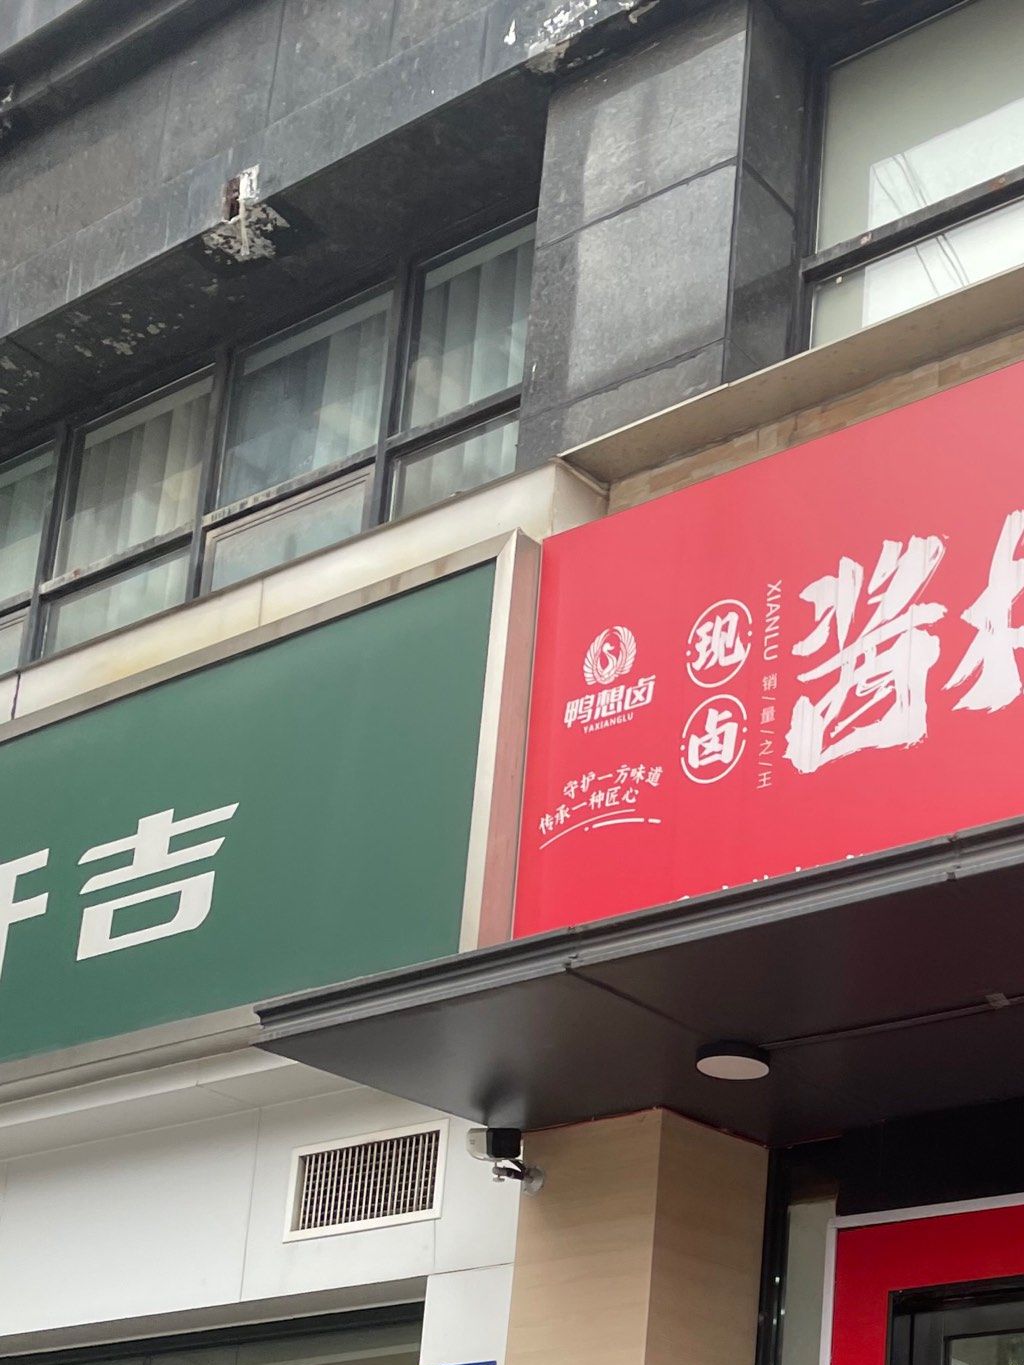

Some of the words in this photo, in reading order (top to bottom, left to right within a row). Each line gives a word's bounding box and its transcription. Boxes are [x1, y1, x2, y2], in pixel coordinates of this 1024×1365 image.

[763, 579, 783, 661] XIANLU
[564, 674, 657, 732] 鸭想卤
[582, 711, 635, 735] YAXIANGLU
[562, 763, 664, 801] 守护一方味道
[537, 786, 640, 835] 传承一种匠心
